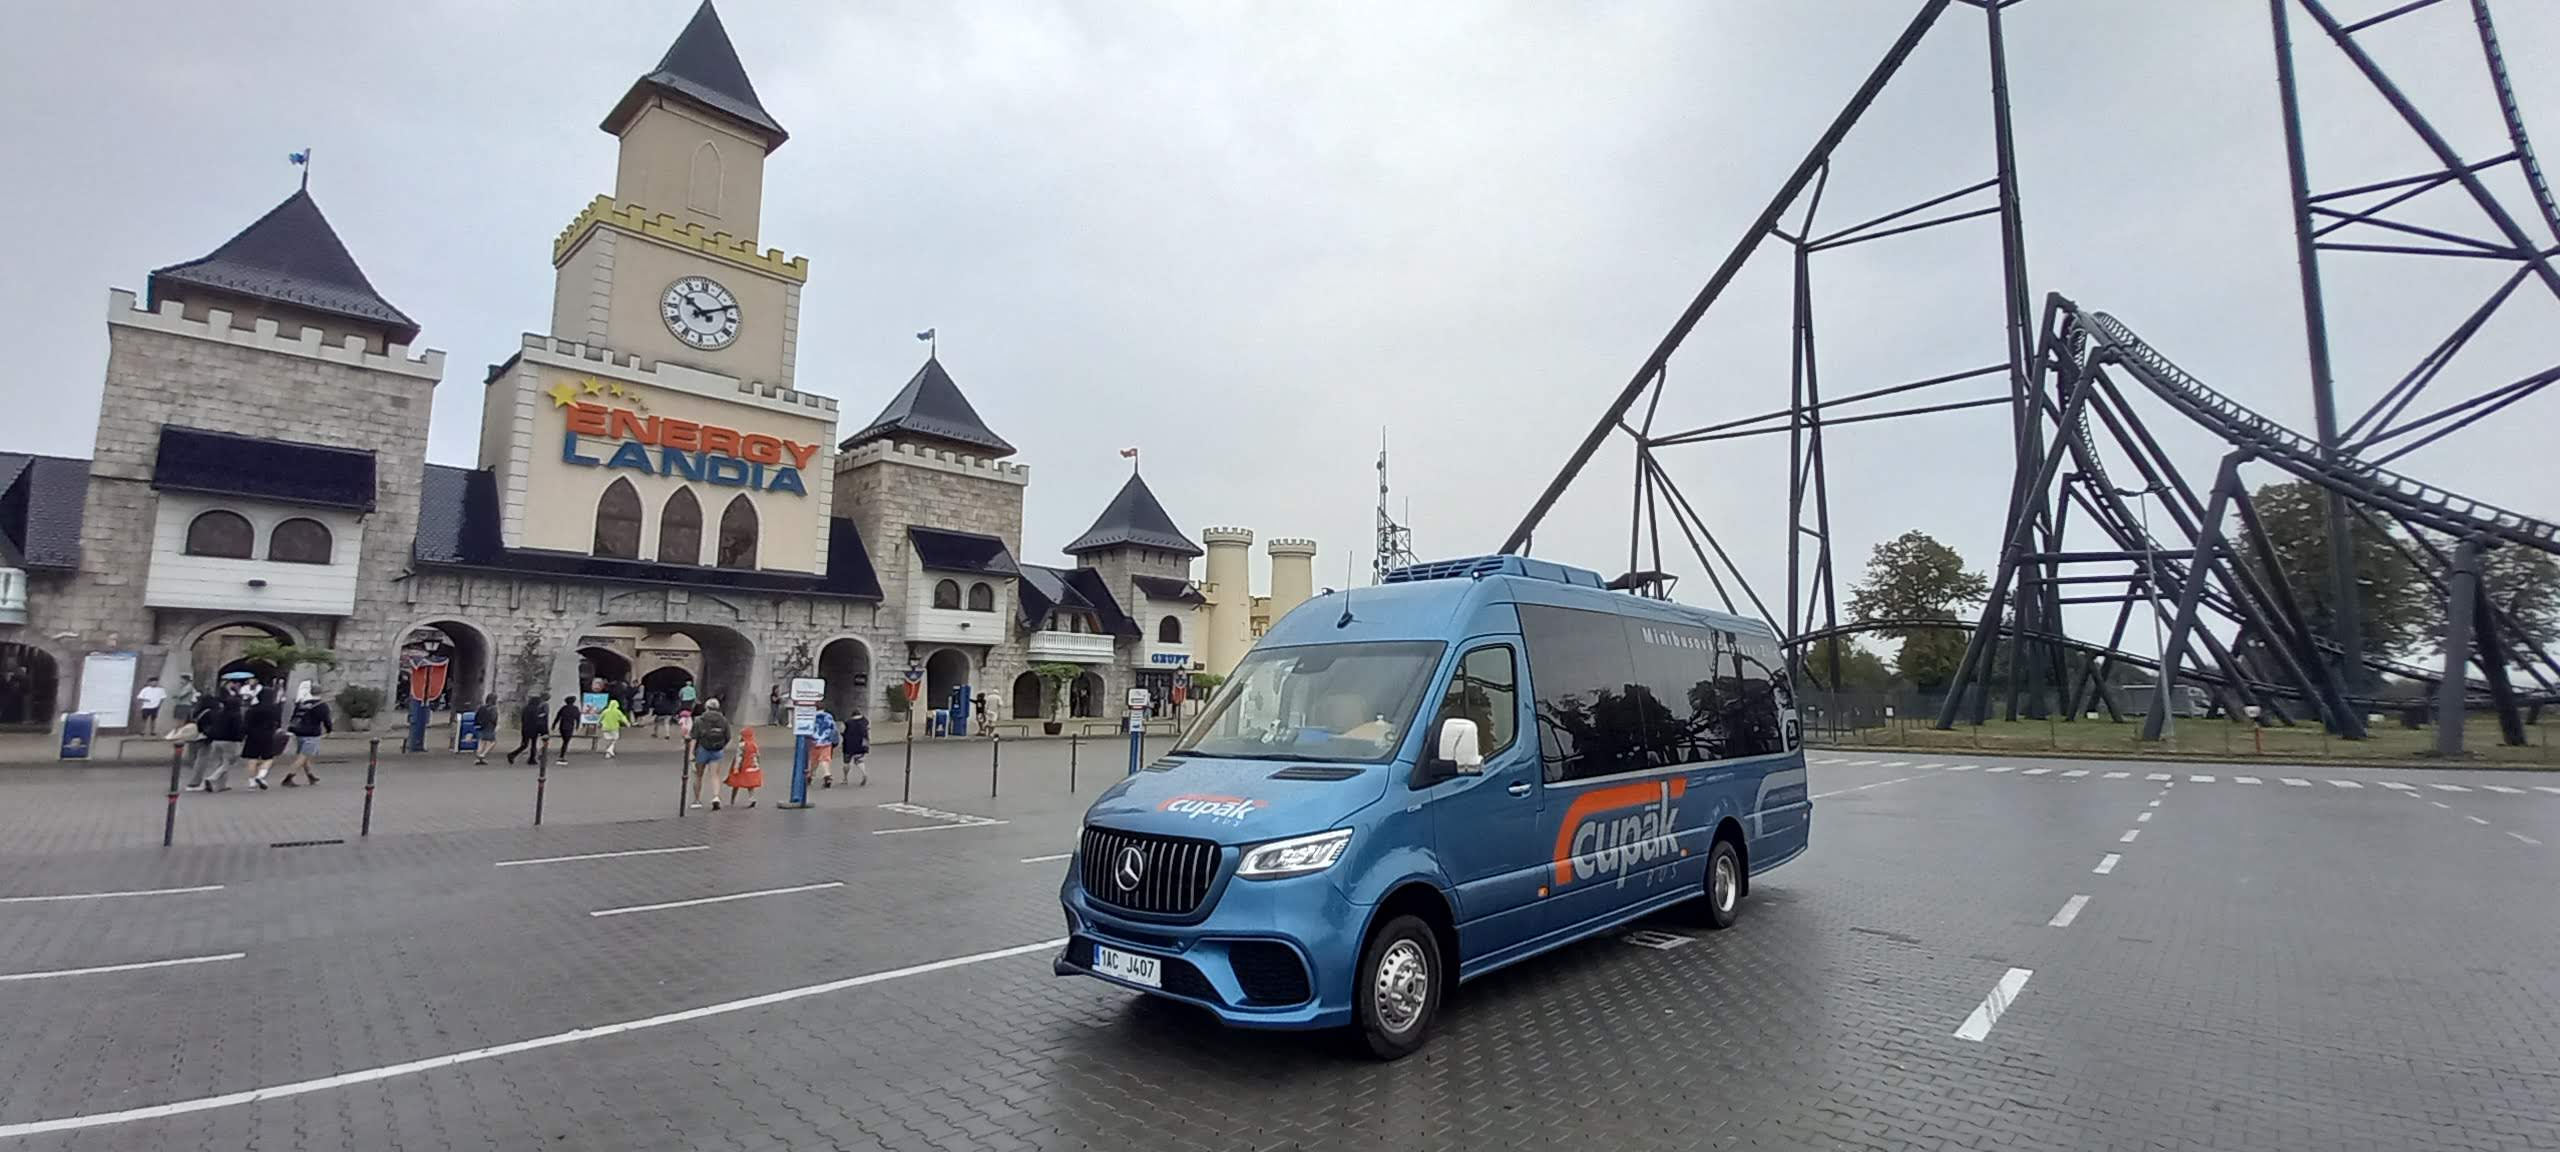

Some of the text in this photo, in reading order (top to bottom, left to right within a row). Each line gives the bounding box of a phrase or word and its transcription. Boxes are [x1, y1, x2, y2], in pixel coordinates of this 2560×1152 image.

[562, 431, 809, 496] LANDIA
[566, 401, 820, 470] ENERGY
[1101, 949, 1155, 978] 1AC J407
